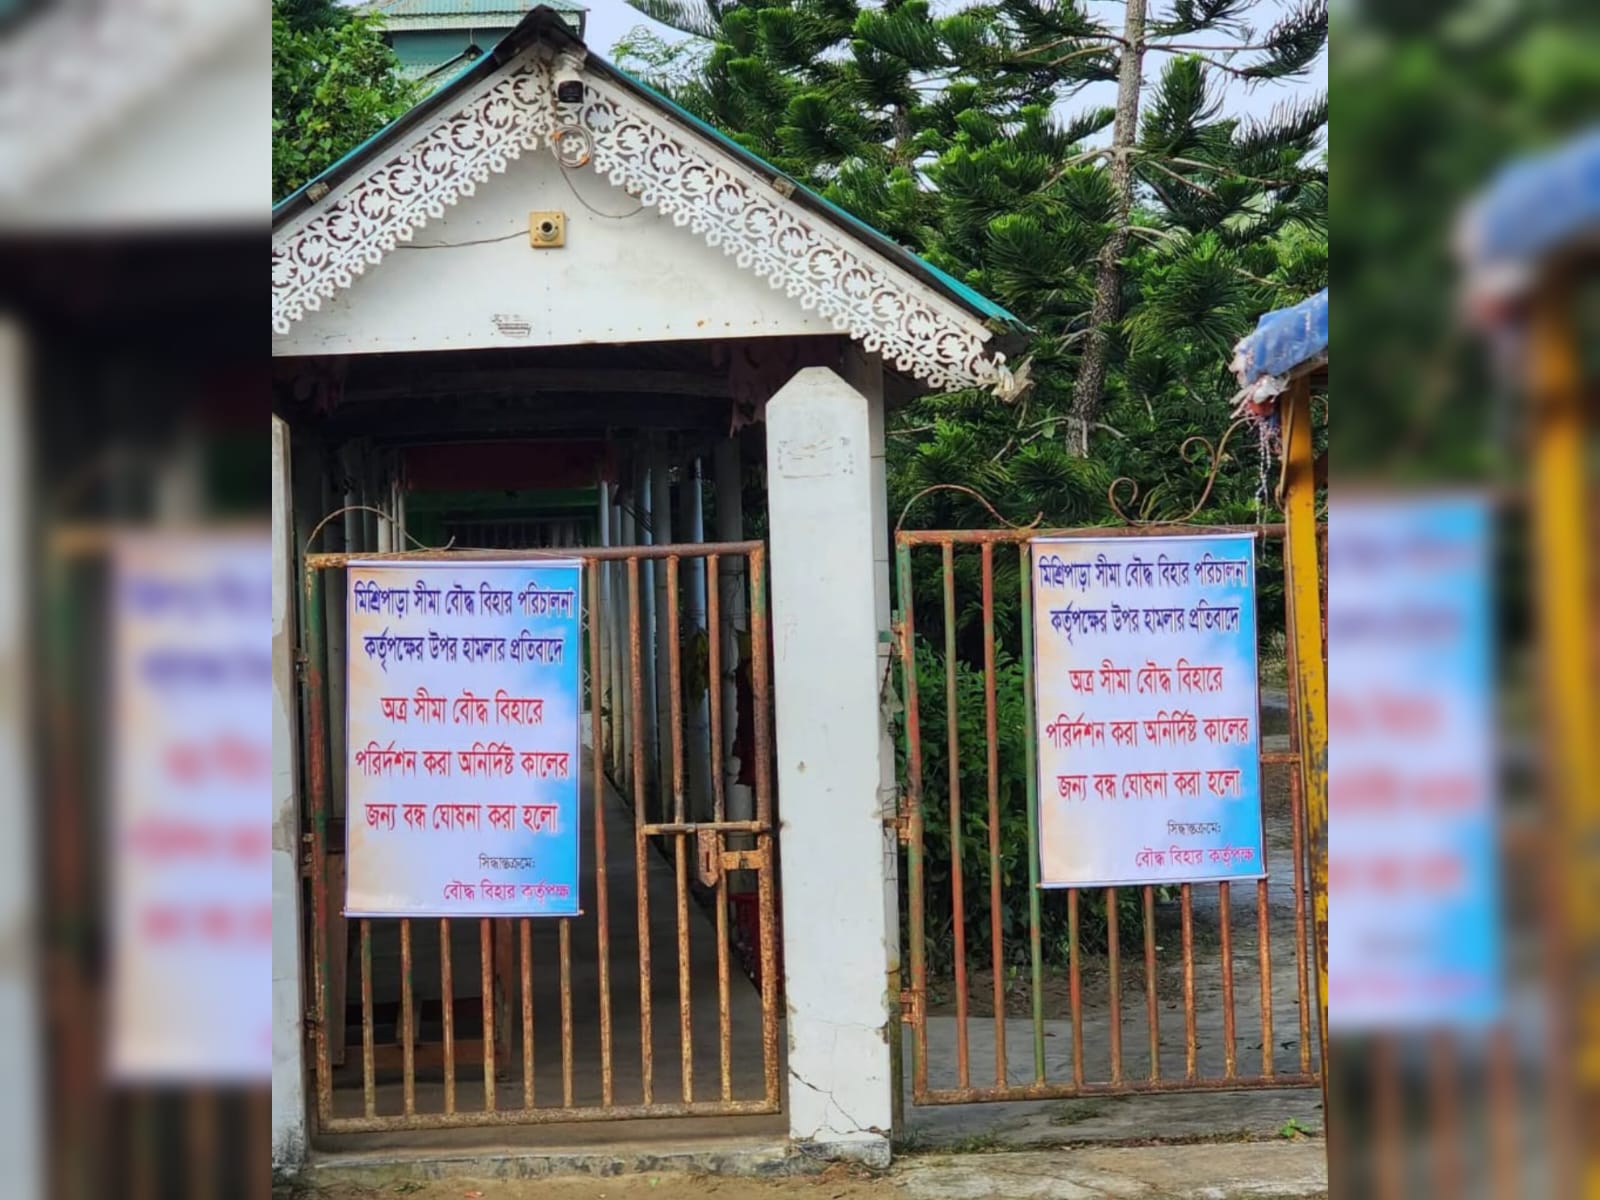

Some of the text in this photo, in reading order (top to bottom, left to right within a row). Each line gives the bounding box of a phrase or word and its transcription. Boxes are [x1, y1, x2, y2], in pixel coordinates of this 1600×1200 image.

[1095, 554, 1121, 588] সীমা
[1126, 557, 1154, 587] বৌদ্ধ
[1158, 554, 1189, 586] বিহার
[1194, 553, 1248, 587] পরিচালনা
[414, 580, 441, 615] সীমা
[445, 585, 475, 616] বৌদ্ধ
[480, 582, 513, 616] বিহার
[517, 582, 574, 618] পরিচালনা
[1050, 599, 1239, 645] কর্তৃপক্ষের উপর হামলার প্রতিবাদে
[363, 627, 564, 672] কর্তৃপক্ষের উপর হামলার প্রতিবাদে
[1069, 658, 1223, 695] অত্র সীমা বৌদ্ধ বিহারে
[380, 687, 544, 725] অত্র সীমা বৌদ্ধ বিহারে
[1110, 722, 1138, 747] করা
[1143, 710, 1197, 747] অনির্দিষ্ট
[1203, 718, 1248, 745] কালের
[422, 752, 452, 776] করা
[458, 742, 514, 776] অনির্দিষ্ট
[520, 753, 569, 779] কালের
[1057, 770, 1240, 801] জন্য বন্ধ ঘোষনা করা হলো
[365, 803, 558, 832] জন্য বন্ধ ঘোষনা করা হলো
[1136, 846, 1165, 868] বৌদ্ধ
[1169, 845, 1203, 865] বিহার
[444, 879, 569, 905] বৌদ্ধ বিহার কর্তৃপক্ষ
